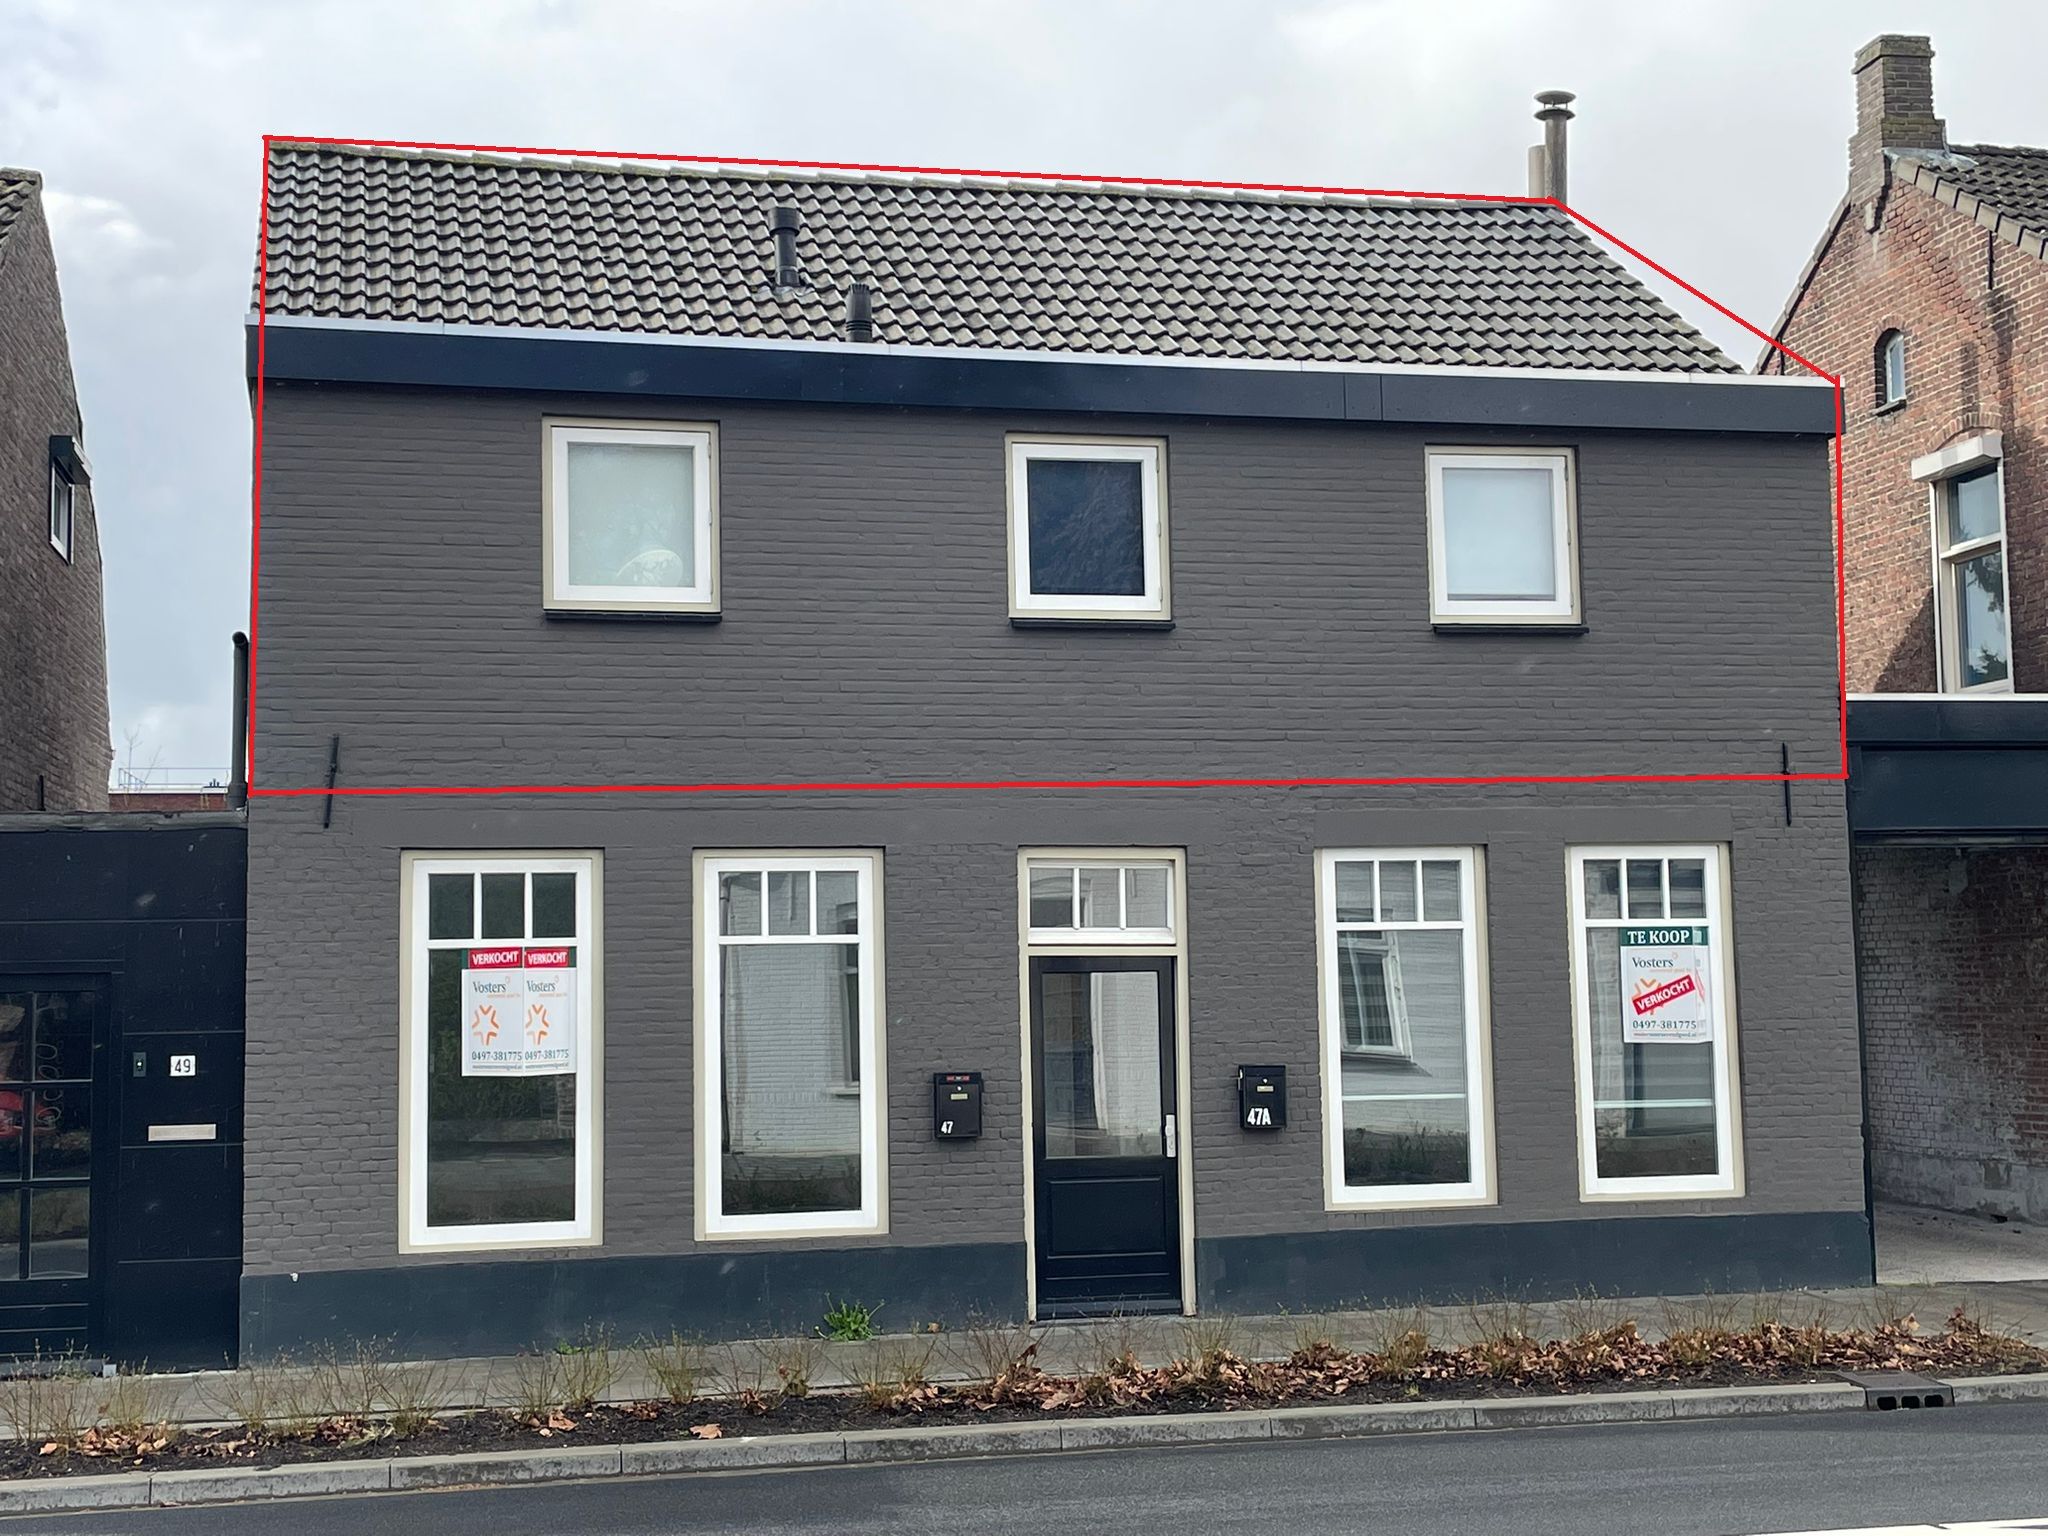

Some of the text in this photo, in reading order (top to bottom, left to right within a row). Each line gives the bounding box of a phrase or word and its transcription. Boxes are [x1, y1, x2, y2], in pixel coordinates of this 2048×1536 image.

[1627, 929, 1690, 944] TE KOOP
[472, 951, 519, 966] VERKOCHT
[527, 951, 568, 966] VERKOCHT
[1632, 957, 1674, 968] Vosters
[472, 981, 507, 993] Vosters
[526, 980, 556, 992] Vosters
[1636, 978, 1691, 1011] VERKOCHT
[1632, 1020, 1697, 1029] 0497-381775
[471, 1050, 522, 1061] 0497-381775
[524, 1048, 569, 1060] 0497-381775
[174, 1058, 191, 1073] 49
[1246, 1107, 1272, 1126] 47A
[940, 1121, 954, 1134] 47
